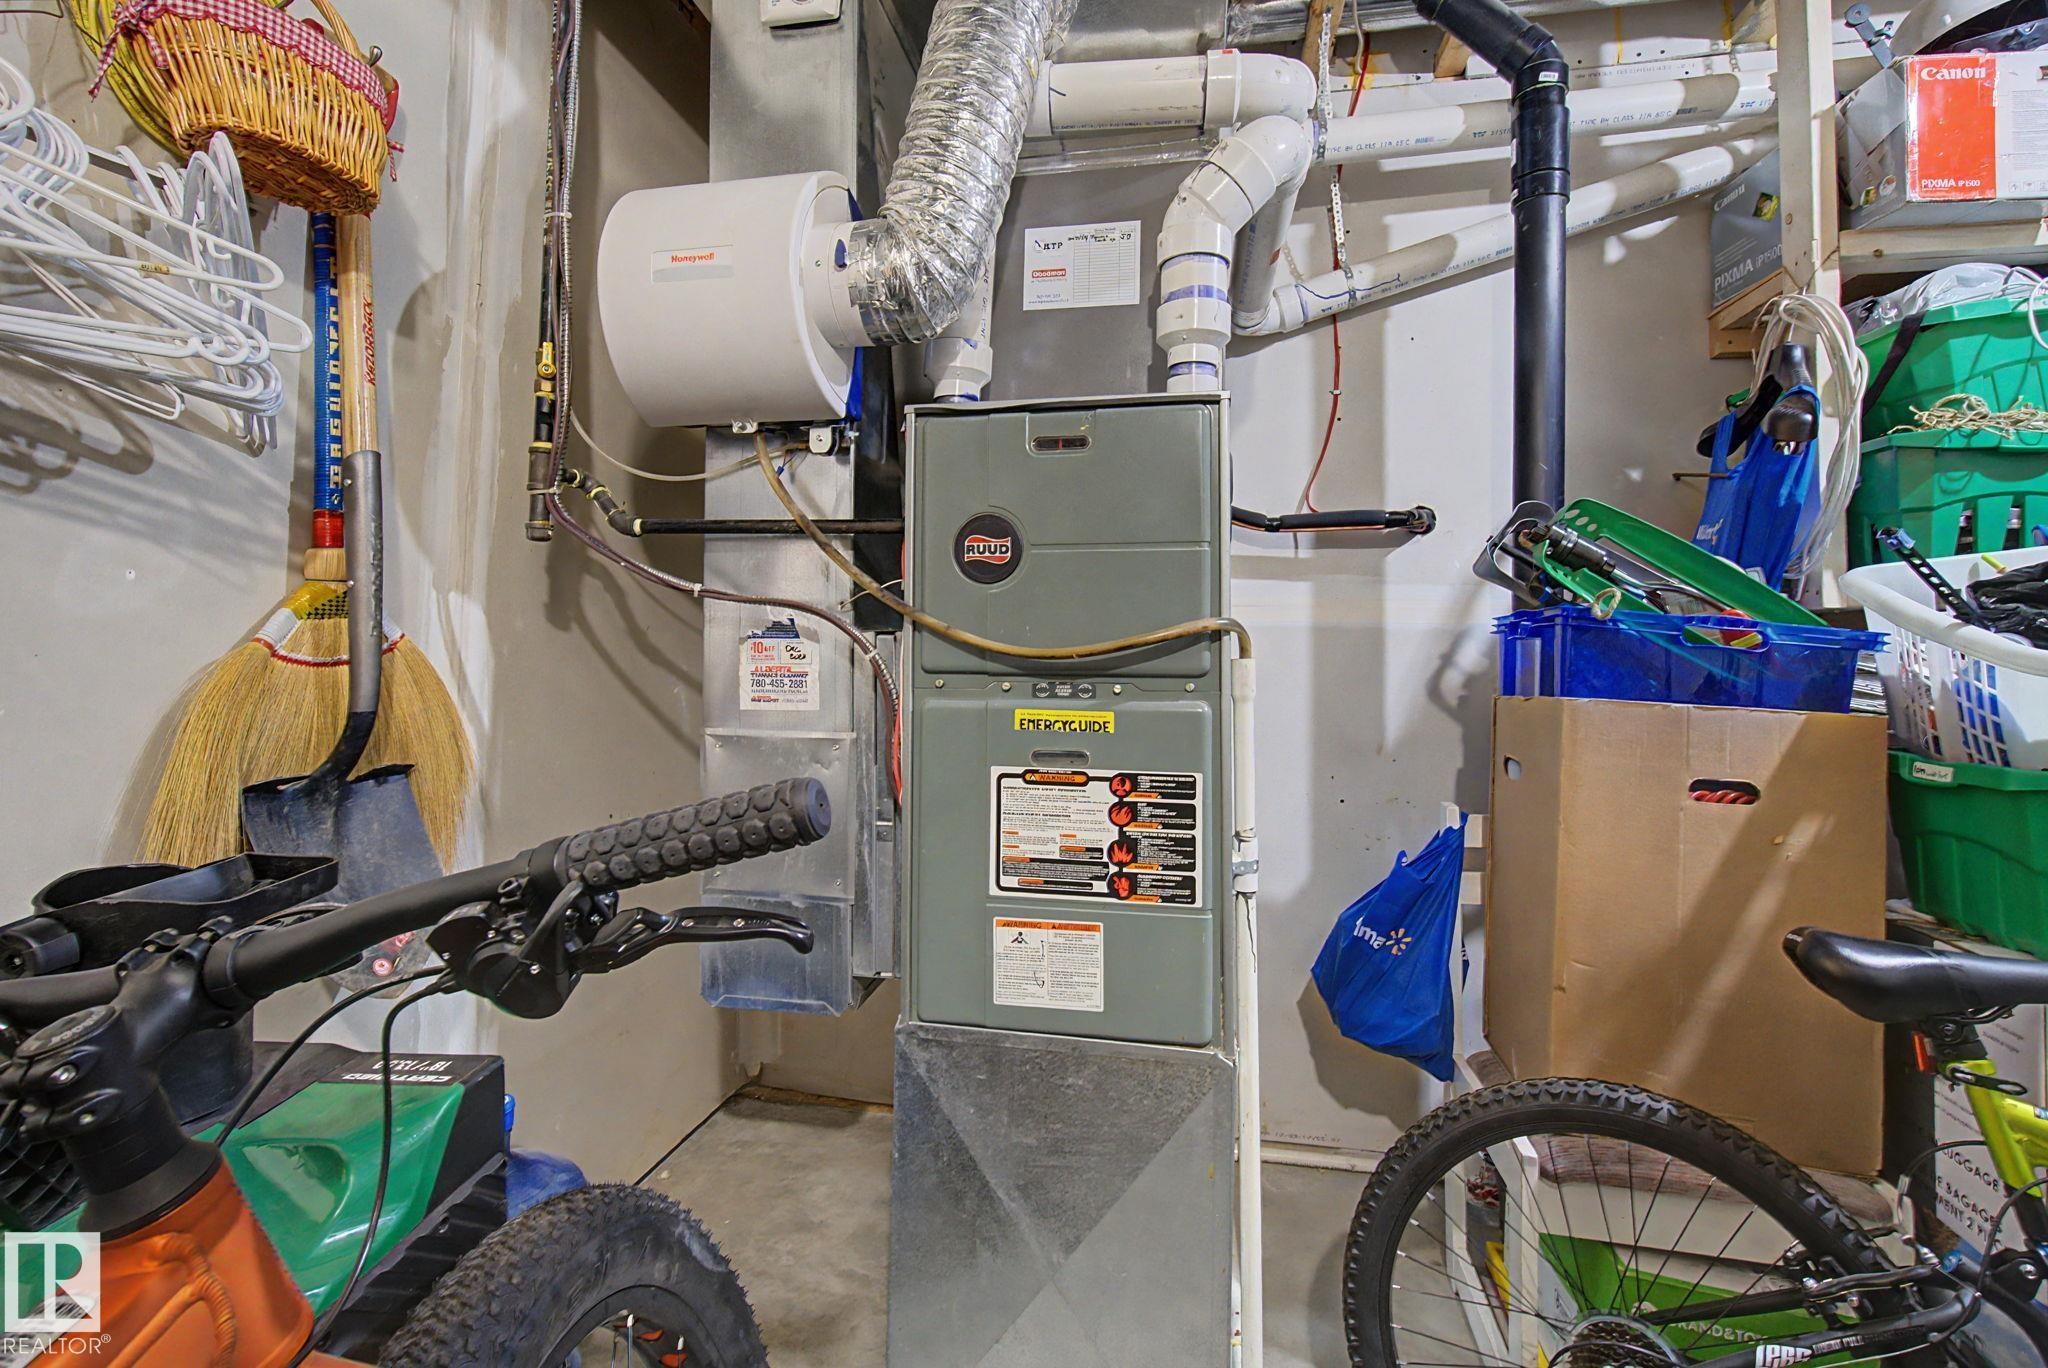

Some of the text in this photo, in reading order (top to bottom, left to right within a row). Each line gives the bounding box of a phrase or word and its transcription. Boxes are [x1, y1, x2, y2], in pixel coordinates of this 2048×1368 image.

[1920, 66, 1987, 81] Canon
[1921, 178, 1956, 188] PIXMA
[1714, 183, 1745, 212] Canon
[671, 252, 715, 263] Honeywell
[1714, 258, 1754, 292] PIXMA
[362, 296, 376, 387] RAZORBACK
[966, 544, 1010, 555] RUUD
[1019, 719, 1111, 733] ENERGYGUIDE
[1040, 774, 1076, 782] WARNING
